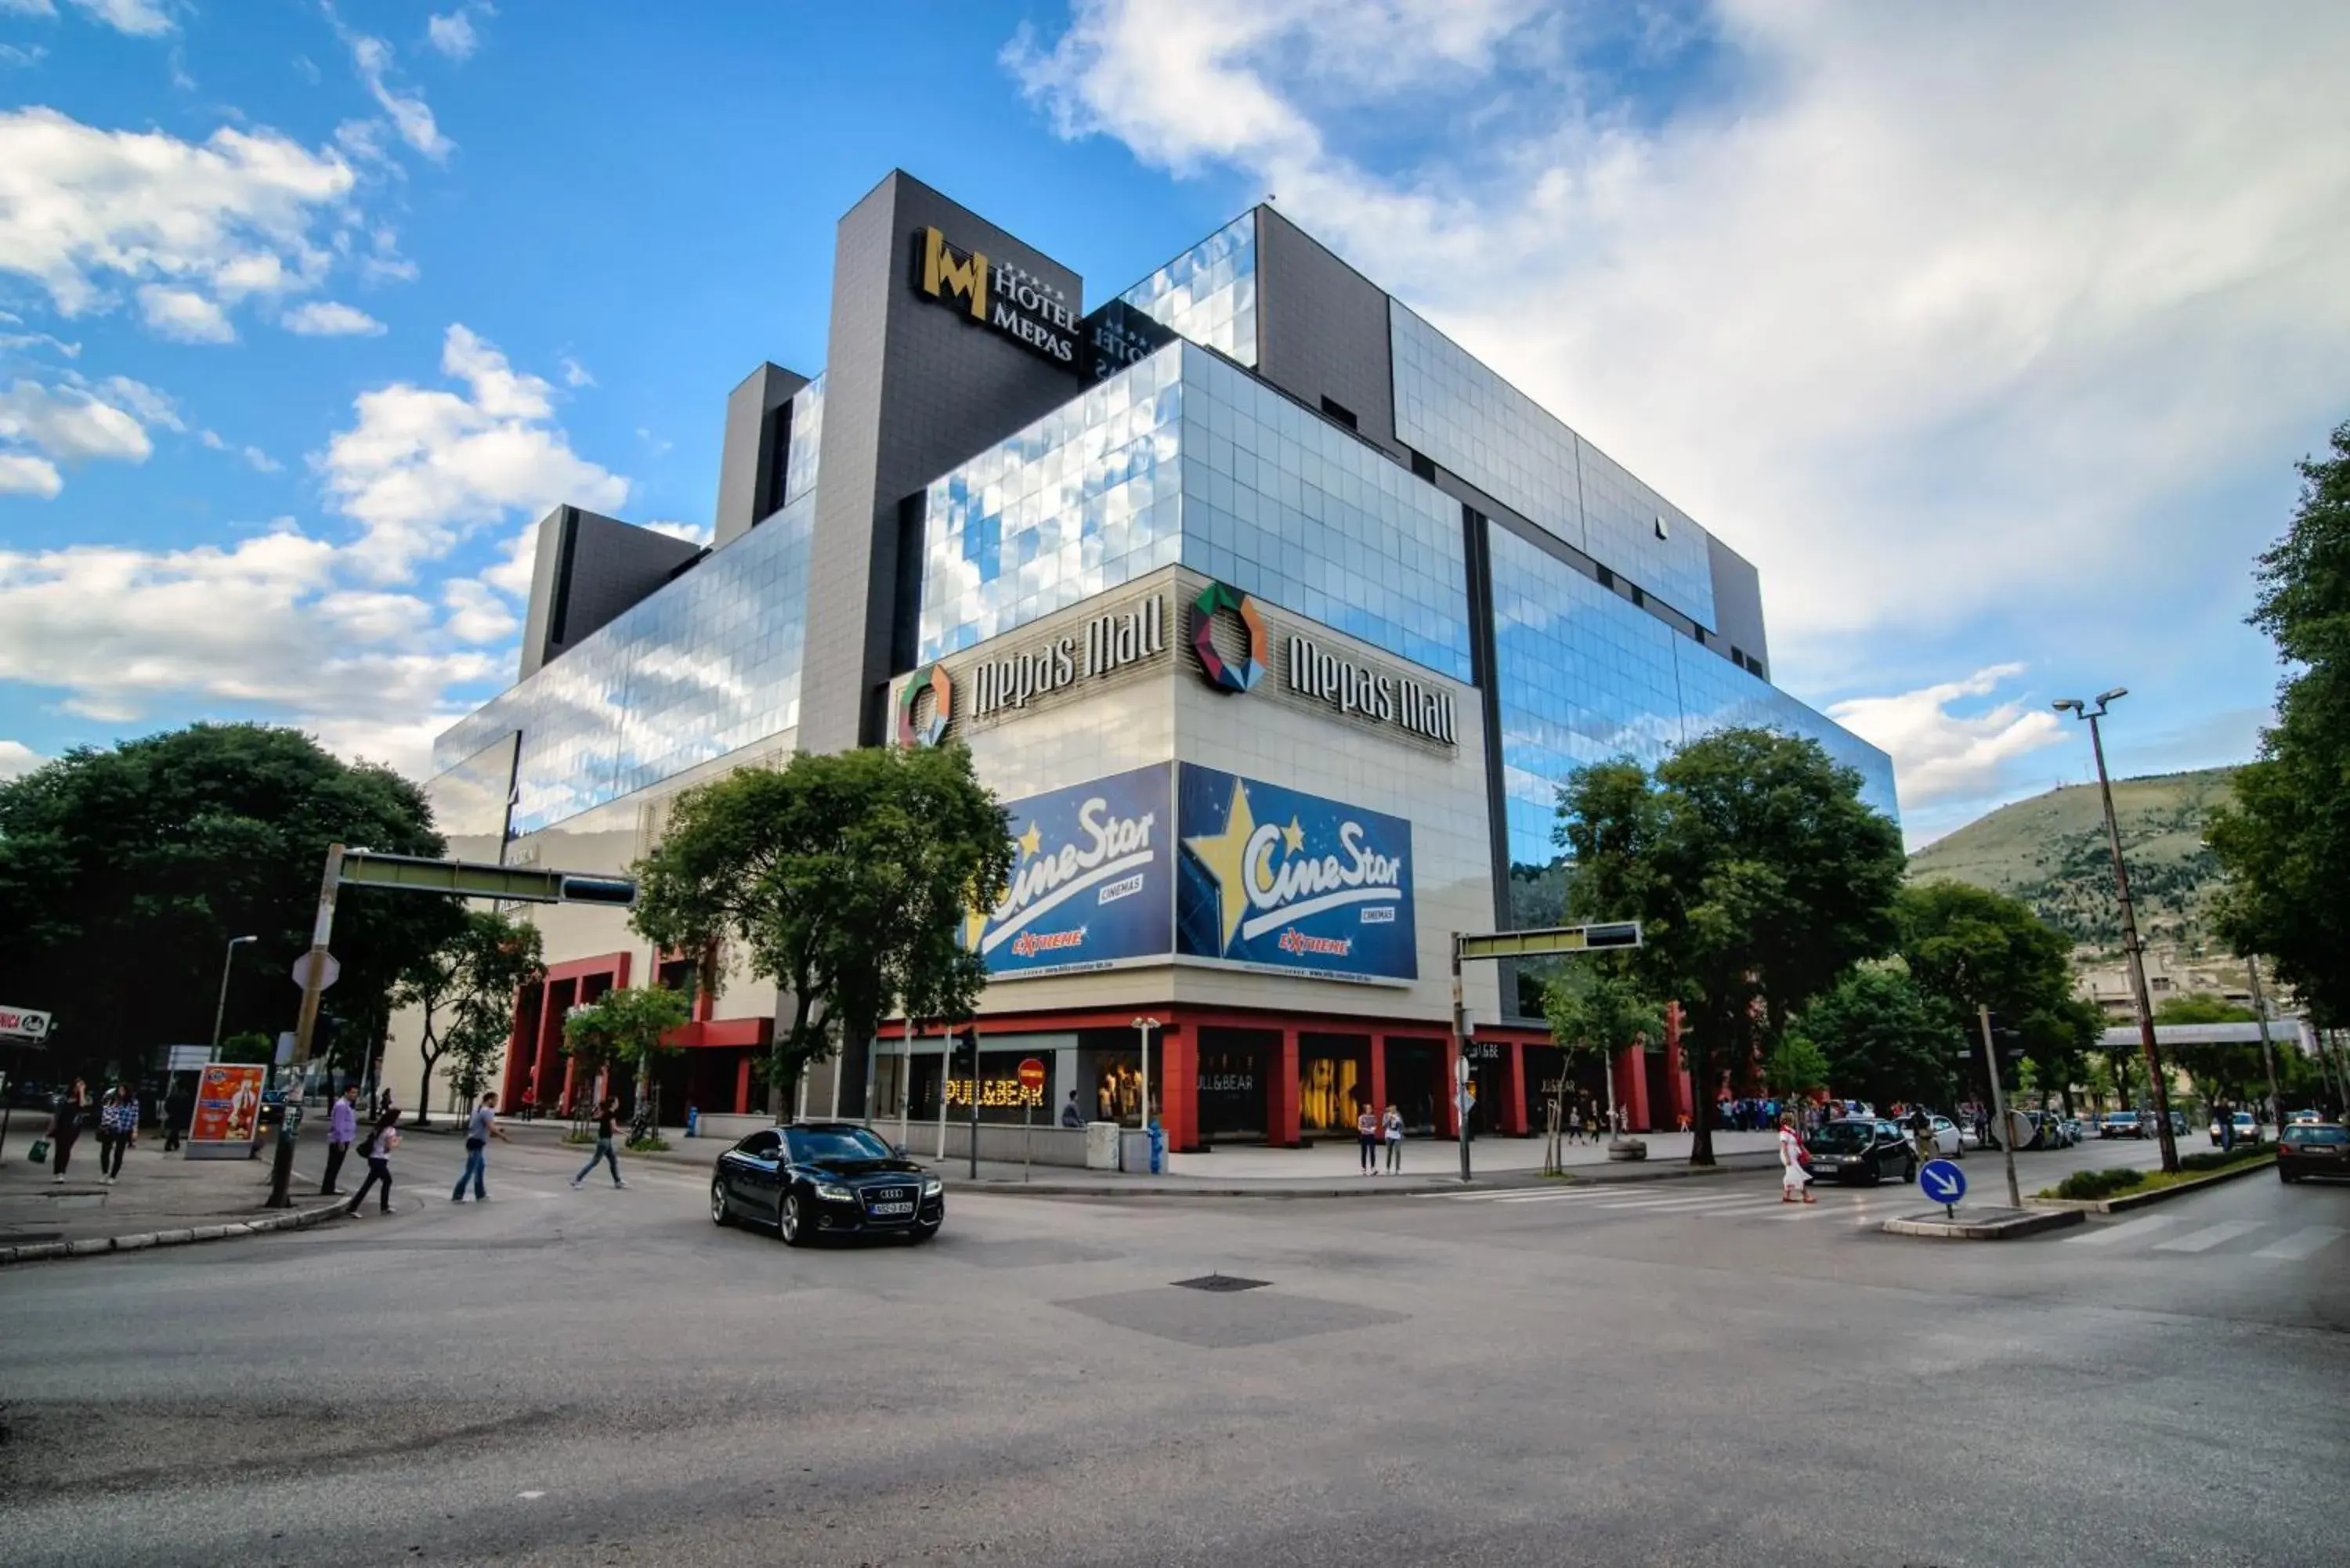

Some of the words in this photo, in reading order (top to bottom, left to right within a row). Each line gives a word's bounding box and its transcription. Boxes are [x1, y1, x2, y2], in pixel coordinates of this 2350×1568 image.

[993, 267, 1080, 335] HOTEL
[993, 302, 1073, 362] MEPAS
[971, 637, 1076, 717] Mepas
[1085, 594, 1165, 678] Mall
[1289, 634, 1393, 721] Mepas
[1400, 679, 1459, 745] Mall
[1101, 877, 1141, 901] CINEMAS
[1244, 821, 1401, 909] CineStar
[1363, 910, 1393, 920] CINEMAS
[945, 1079, 1043, 1107] PULL&BEAR
